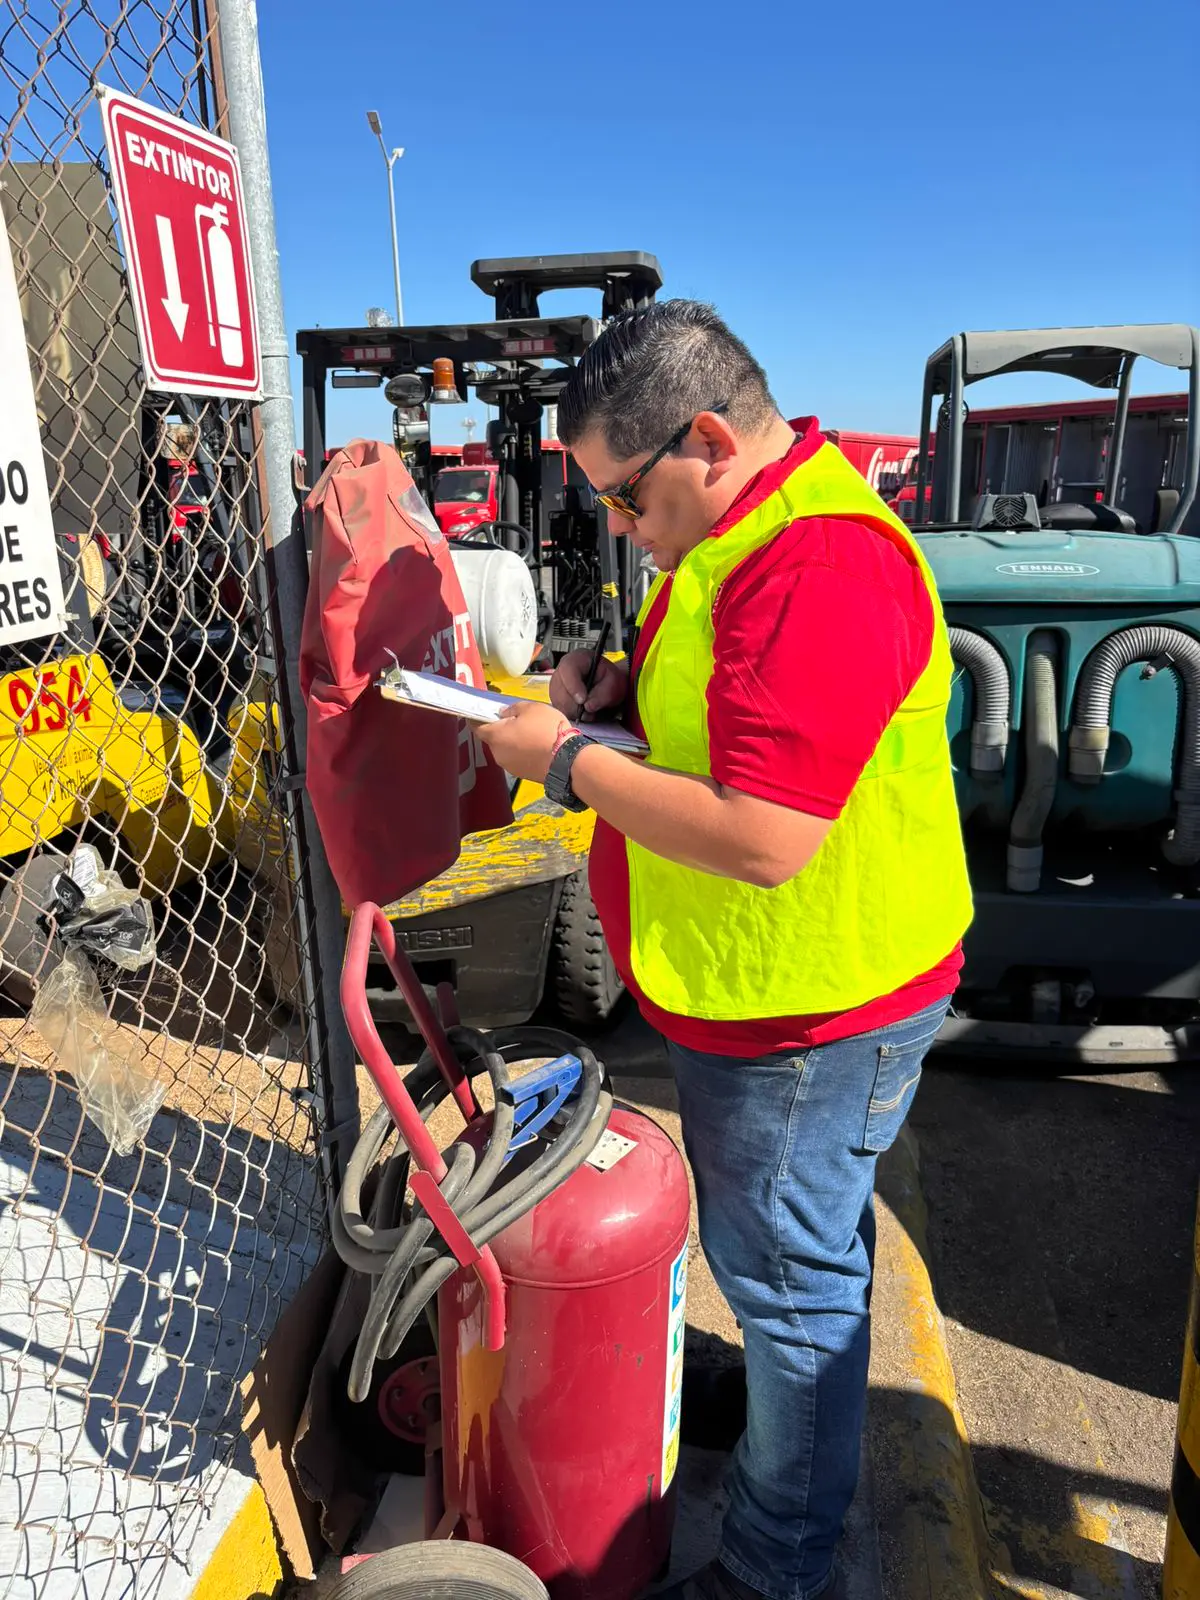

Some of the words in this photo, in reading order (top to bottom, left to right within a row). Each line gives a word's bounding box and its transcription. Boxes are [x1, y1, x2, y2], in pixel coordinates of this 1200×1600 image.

[125, 130, 233, 201] EXTINTOR
[0, 460, 28, 505] O
[0, 525, 23, 564] E
[1009, 564, 1084, 574] TENNANT
[9, 665, 91, 736] 954
